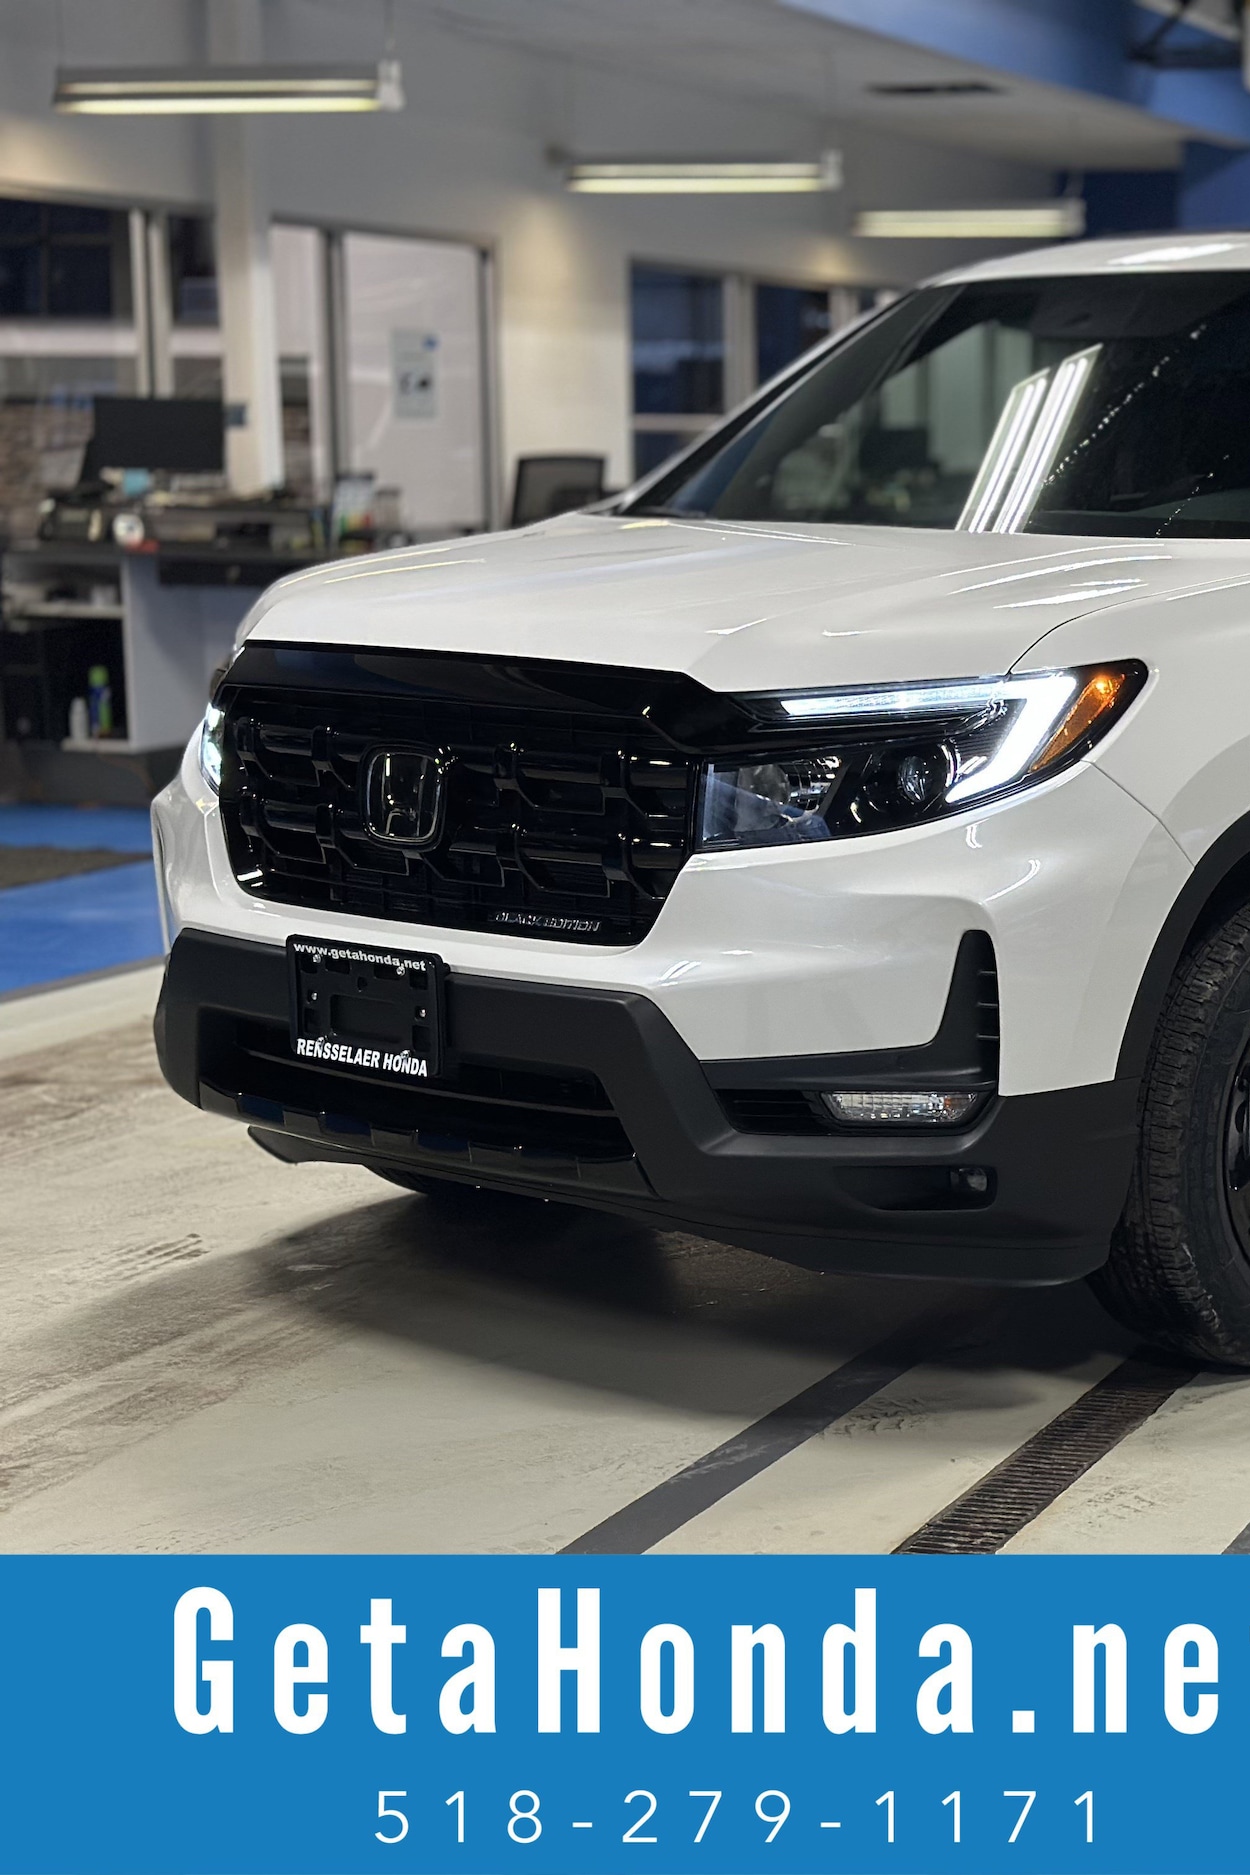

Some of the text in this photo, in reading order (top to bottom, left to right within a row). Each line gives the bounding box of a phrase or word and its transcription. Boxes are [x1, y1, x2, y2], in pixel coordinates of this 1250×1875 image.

[293, 942, 427, 972] www.getahonda.net
[296, 1038, 428, 1077] RENSSELAER HONDA
